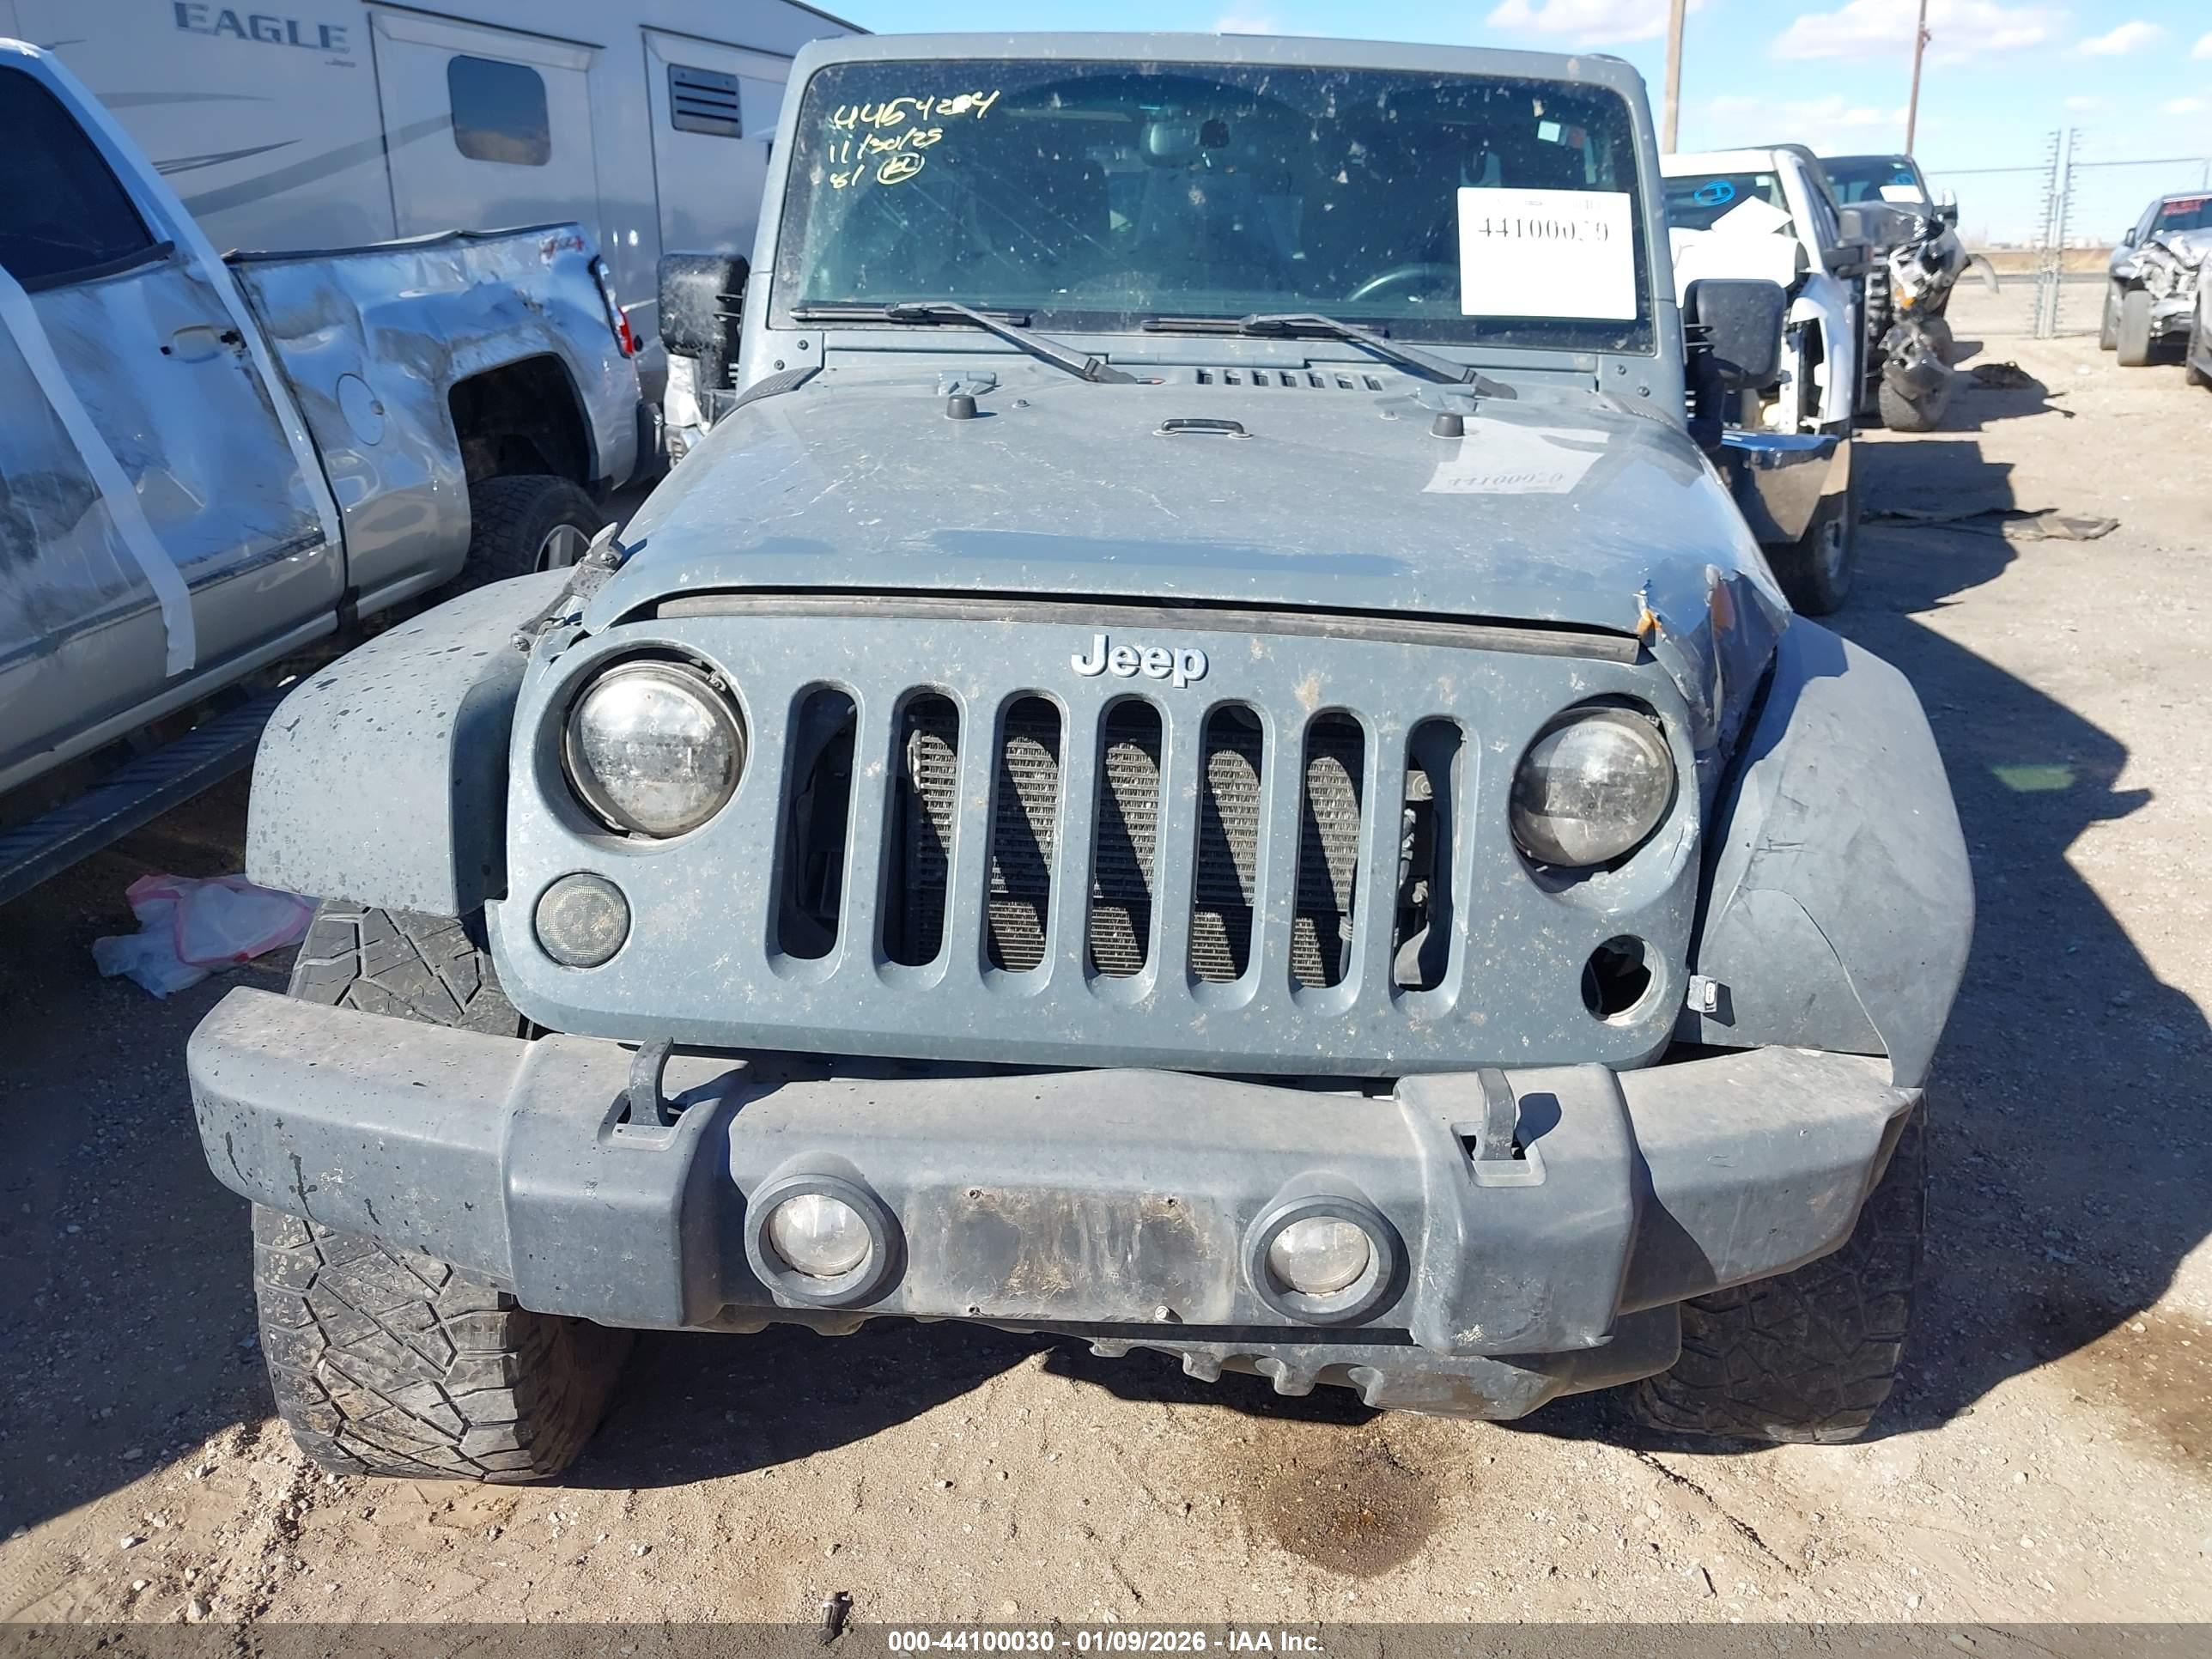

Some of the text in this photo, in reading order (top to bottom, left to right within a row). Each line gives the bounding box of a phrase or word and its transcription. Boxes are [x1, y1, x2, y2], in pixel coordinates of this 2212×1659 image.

[173, 2, 350, 54] EAGLE
[1479, 217, 1608, 241] 4410000
[1071, 634, 1209, 689] Jeep
